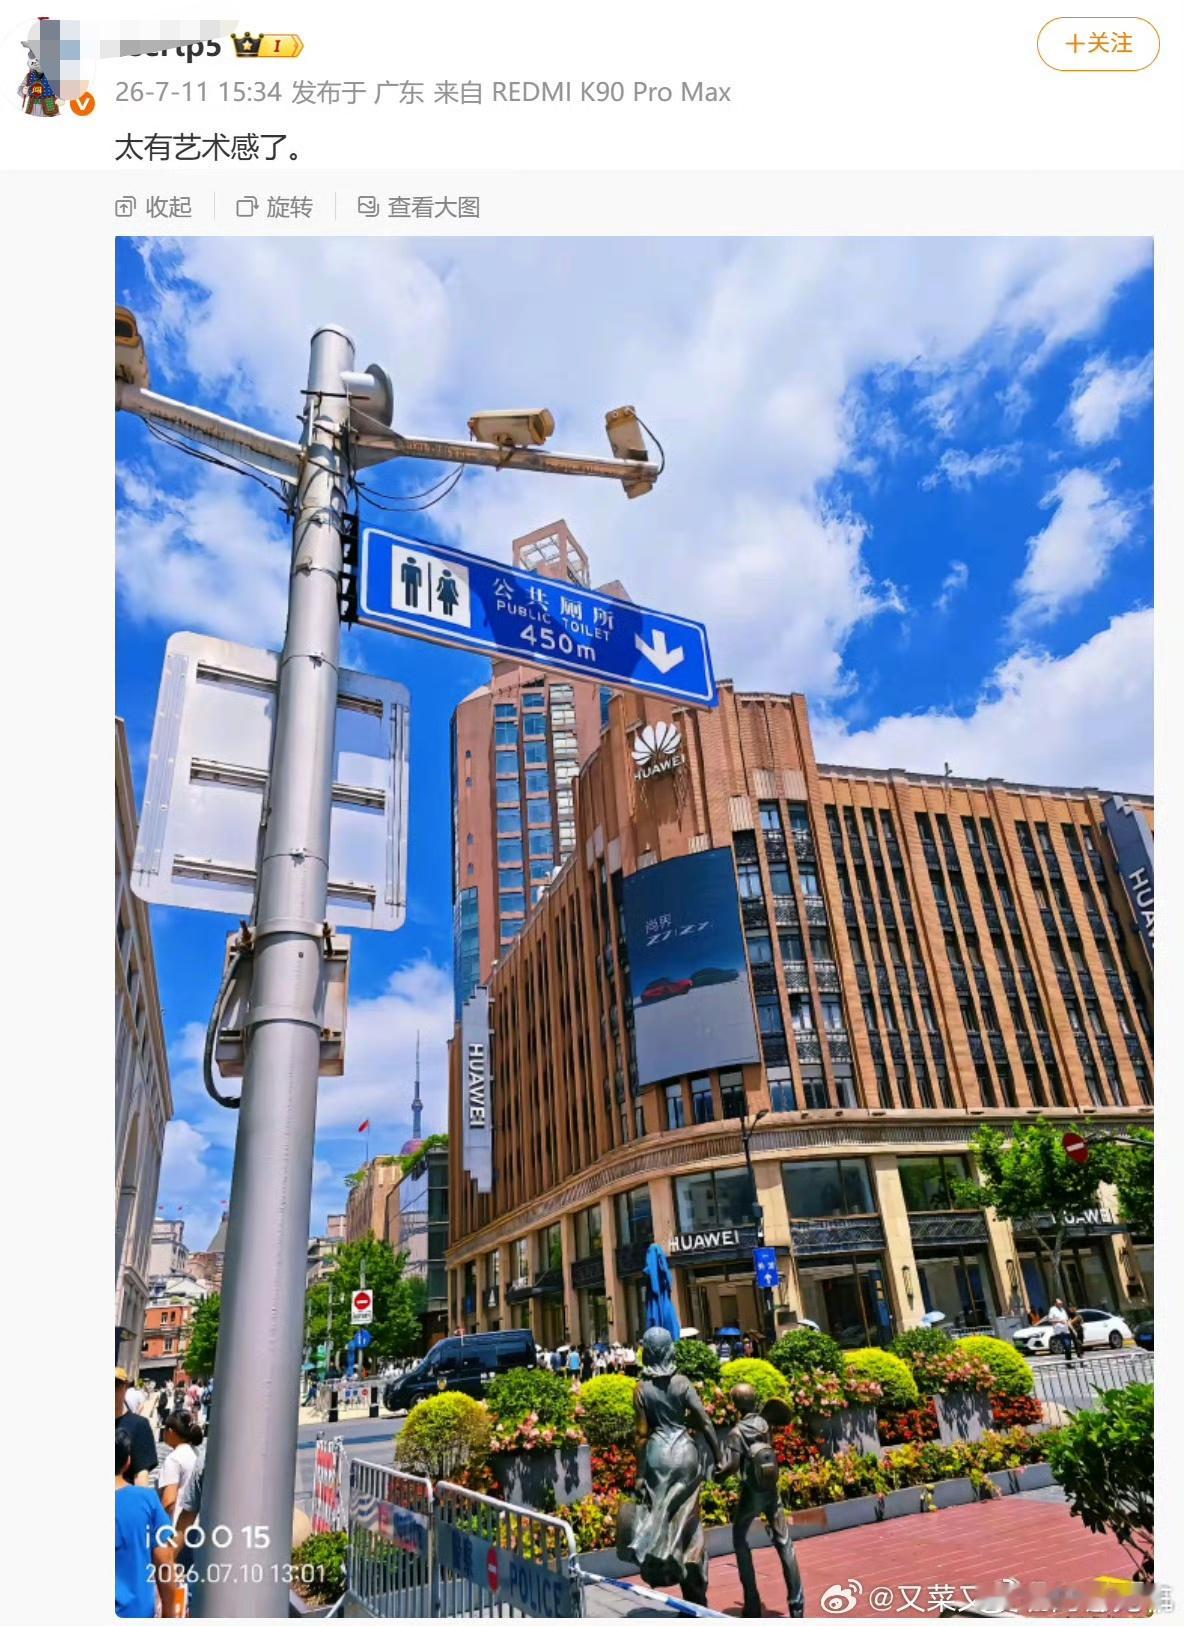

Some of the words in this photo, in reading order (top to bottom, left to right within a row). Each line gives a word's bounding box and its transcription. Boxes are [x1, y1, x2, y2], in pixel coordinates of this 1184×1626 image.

[496, 599, 552, 625] PUBLIC
[561, 616, 611, 642] TOILET
[519, 624, 597, 663] 450m
[634, 753, 686, 781] HUAWEI
[1128, 866, 1154, 947] HUA
[469, 1043, 486, 1130] HUAWEI
[668, 1229, 740, 1252] HUAWEI
[509, 1560, 564, 1617] POLICE
